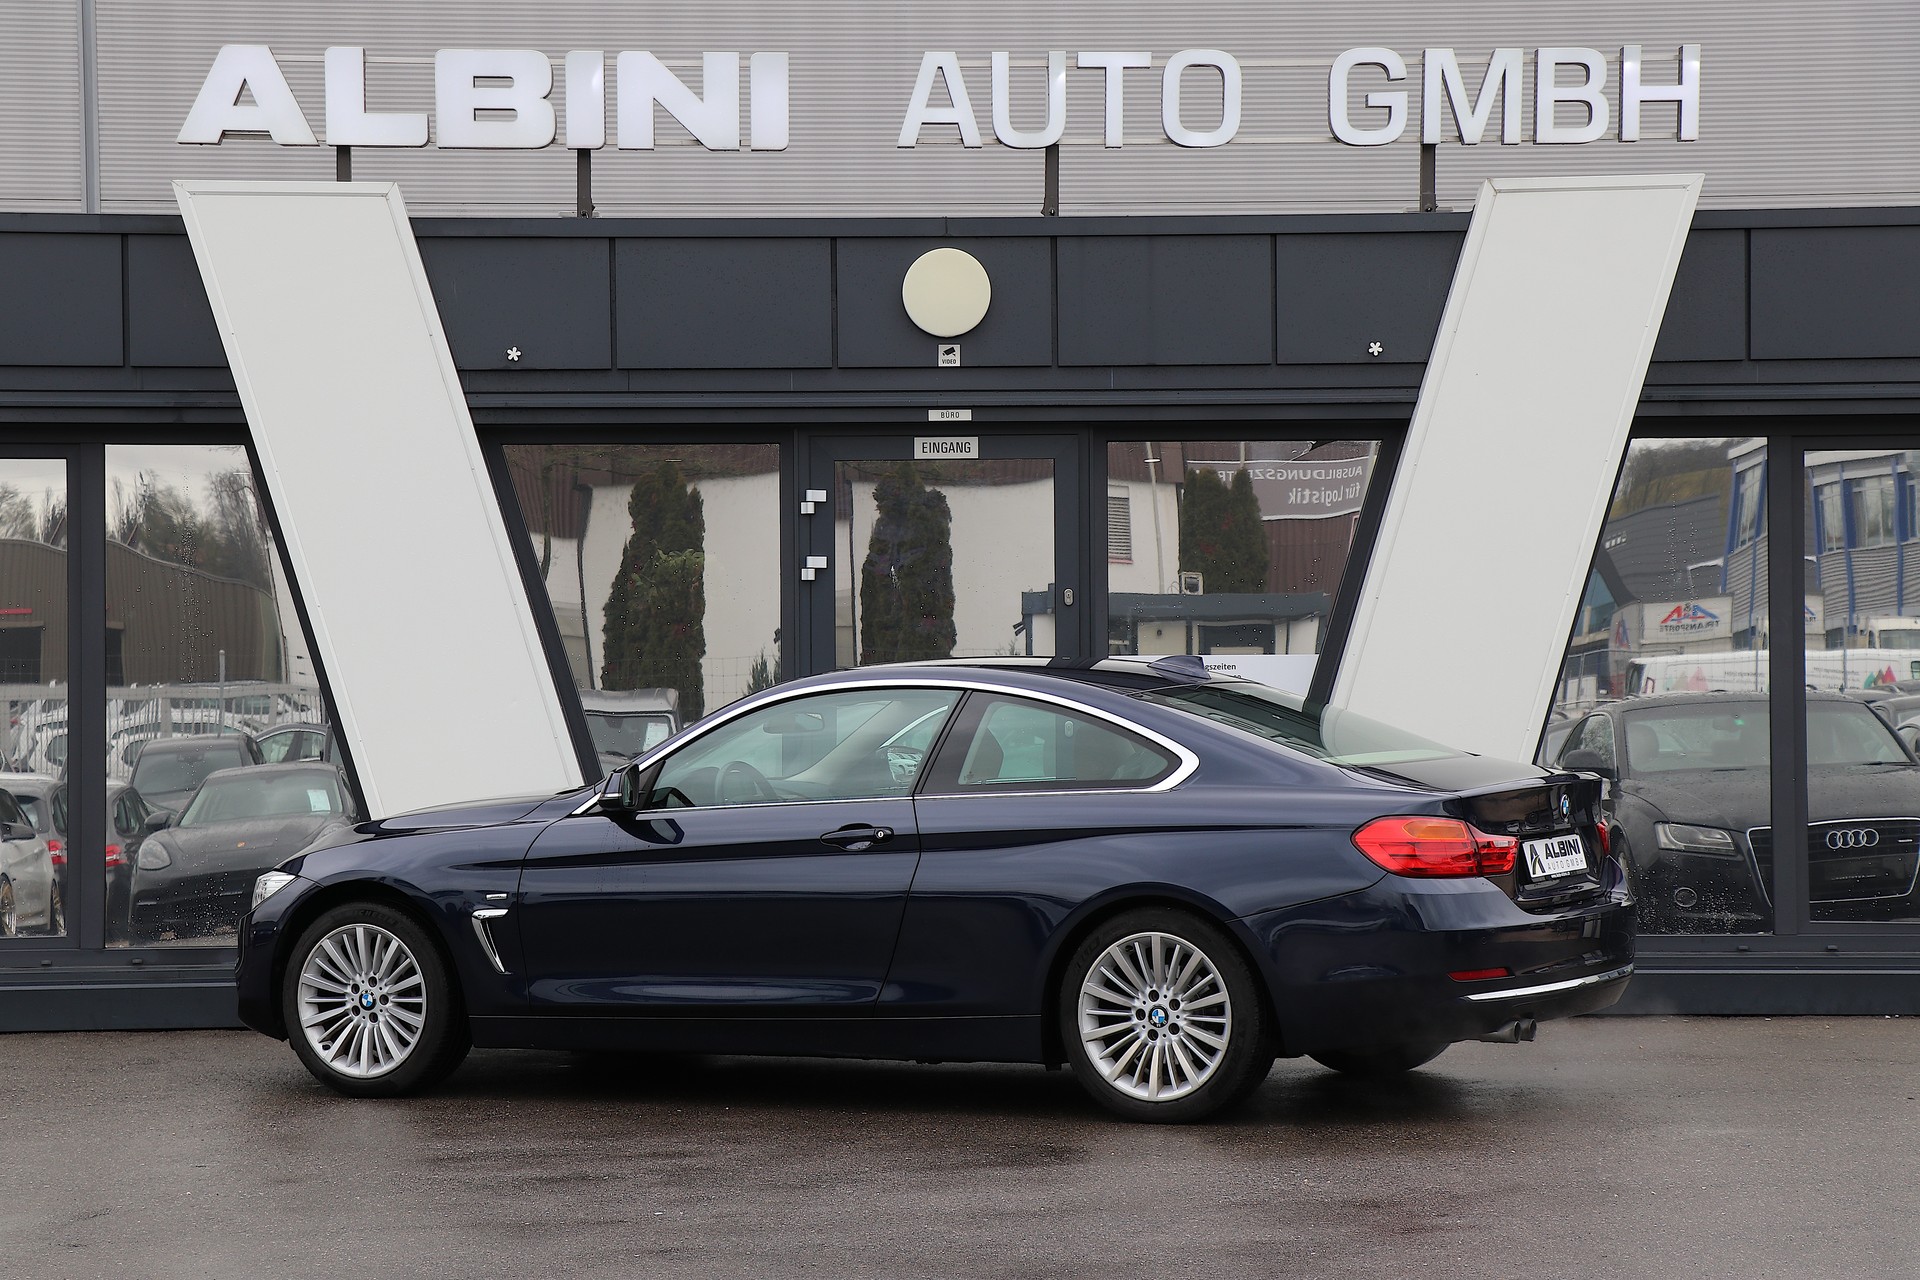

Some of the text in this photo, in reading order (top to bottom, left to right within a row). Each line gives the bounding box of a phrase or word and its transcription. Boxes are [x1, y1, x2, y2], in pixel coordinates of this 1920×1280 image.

[177, 45, 1700, 151] ALBINI AUTO GMBH
[940, 411, 960, 419] BÜRO
[922, 442, 971, 453] EINGANG
[1205, 663, 1237, 671] gszeiten
[1544, 839, 1581, 859] ALBINI
[1547, 861, 1564, 871] AUTO
